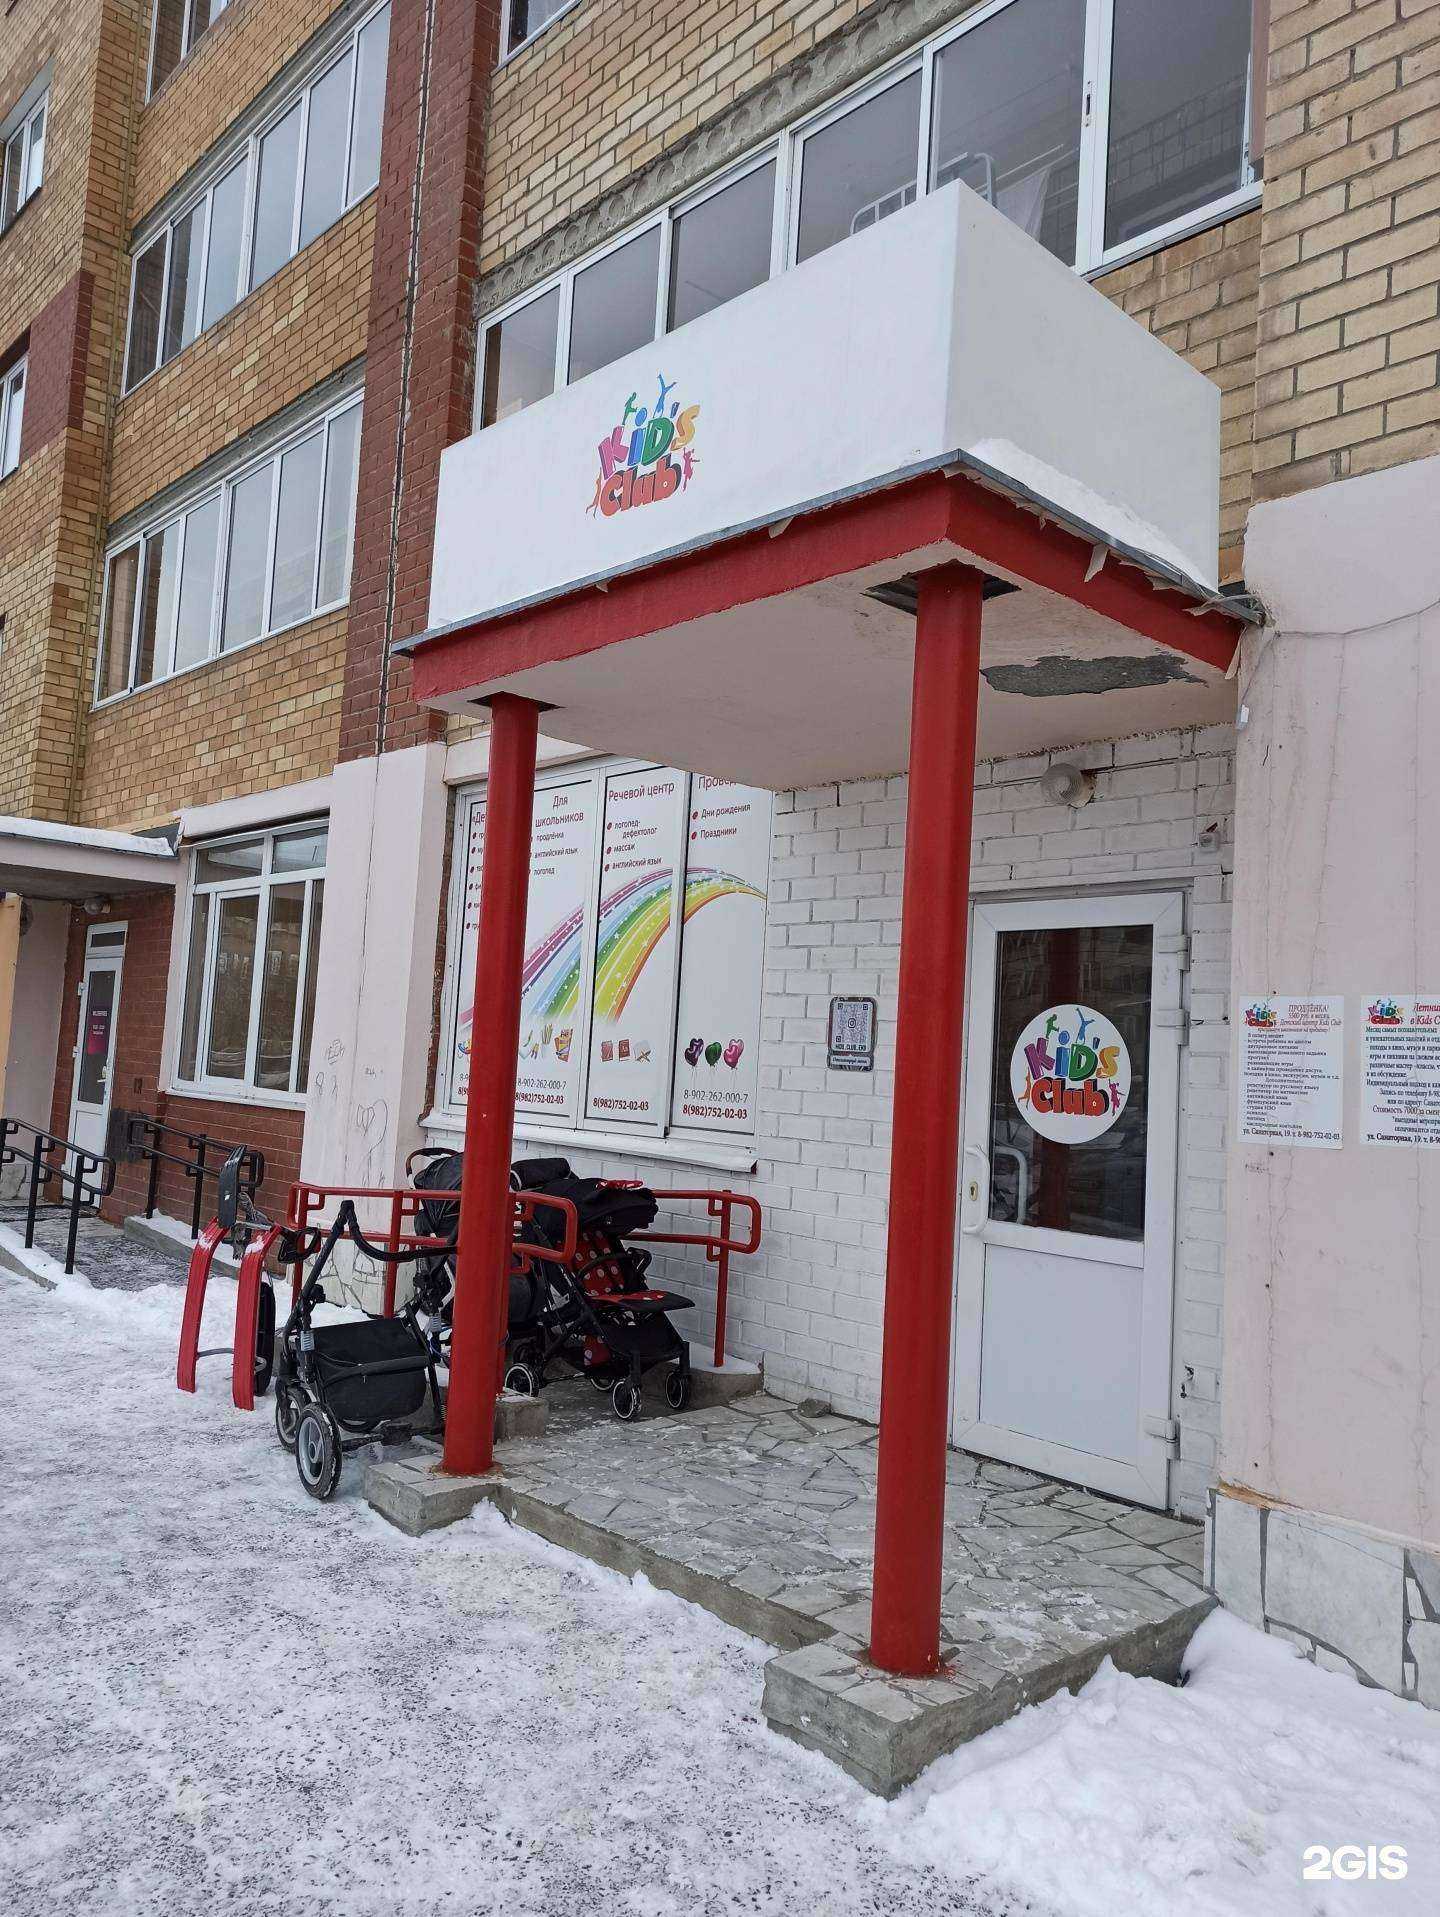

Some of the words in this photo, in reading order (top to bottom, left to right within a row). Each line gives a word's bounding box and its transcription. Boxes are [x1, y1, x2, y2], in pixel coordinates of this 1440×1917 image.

[608, 785, 645, 802] Речевой
[648, 781, 675, 799] центр
[553, 795, 568, 809] Для
[701, 808, 715, 819] Дни
[716, 804, 751, 818] рождения
[535, 812, 584, 828] школьников
[622, 827, 658, 839] дефектолог
[700, 827, 738, 840] Праздники
[565, 847, 578, 855] язык
[613, 843, 635, 852] массаж
[612, 858, 646, 870] английский
[647, 857, 662, 866] язык
[683, 1089, 749, 1104] 8-902-262-000-7
[593, 1097, 649, 1111] 8(982)752-02-03
[682, 1104, 748, 1120] 8(982)752-02-03
